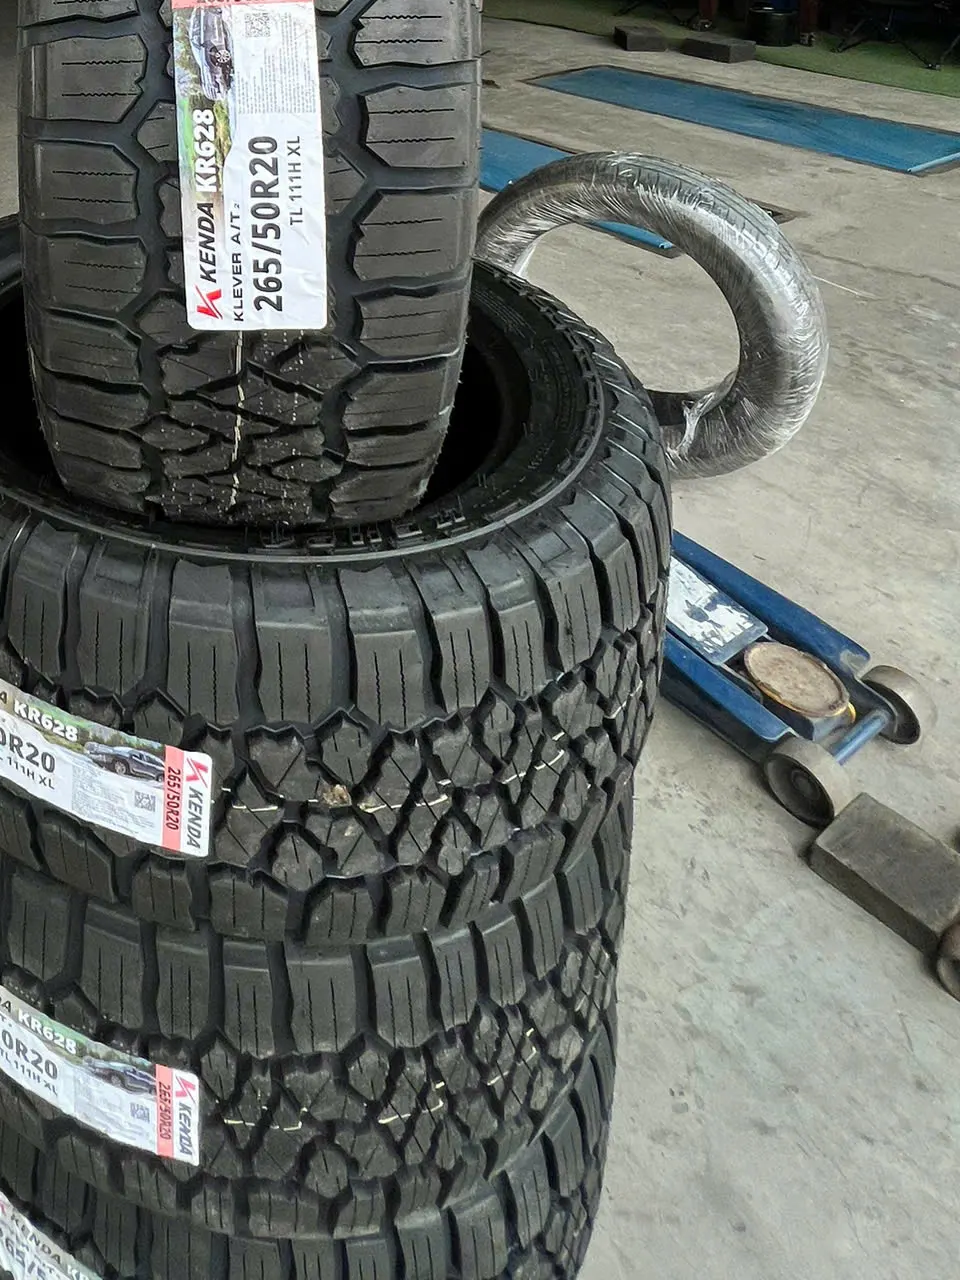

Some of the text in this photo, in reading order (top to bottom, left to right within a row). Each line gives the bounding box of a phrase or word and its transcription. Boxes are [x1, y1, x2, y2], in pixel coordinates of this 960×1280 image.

[193, 109, 216, 283] KENDA KR628
[287, 136, 303, 225] TL 111H XL
[248, 136, 283, 312] 265/50R20
[232, 253, 244, 321] KLEVER
[14, 699, 79, 743] KR628
[7, 761, 35, 781] 111H
[39, 774, 55, 789] XL
[166, 767, 181, 830] 265/50R20
[187, 786, 203, 849] KENDA
[17, 1008, 77, 1054] KR628
[159, 1081, 171, 1140] 265/50R20
[178, 1102, 193, 1156] KENDA
